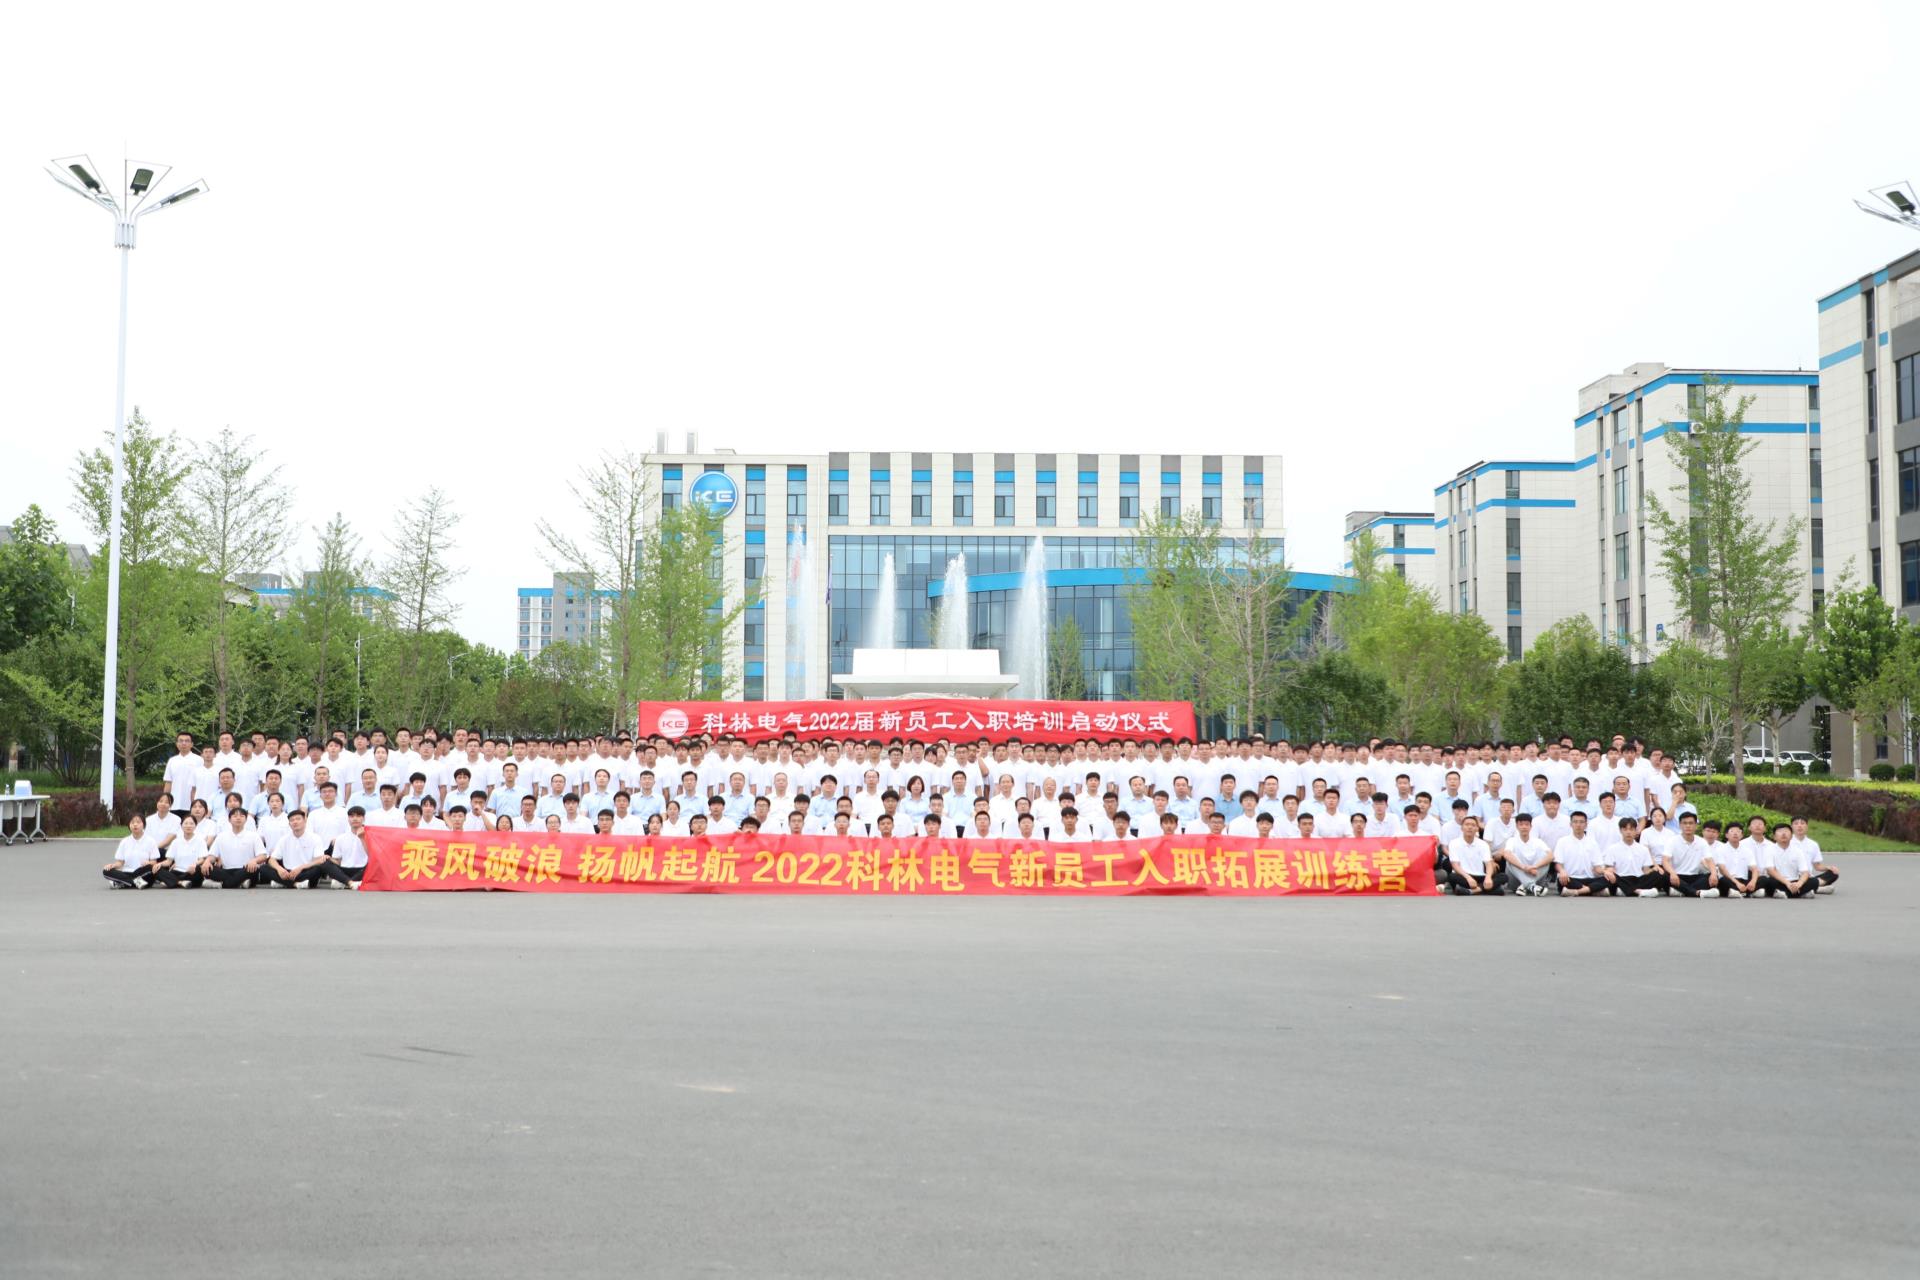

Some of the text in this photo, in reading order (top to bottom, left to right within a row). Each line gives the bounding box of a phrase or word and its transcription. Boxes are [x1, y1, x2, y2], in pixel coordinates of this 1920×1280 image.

[700, 711, 1174, 734] 科林电气2022届新员工入职培训启动仪式
[399, 840, 563, 883] 乘风破浪
